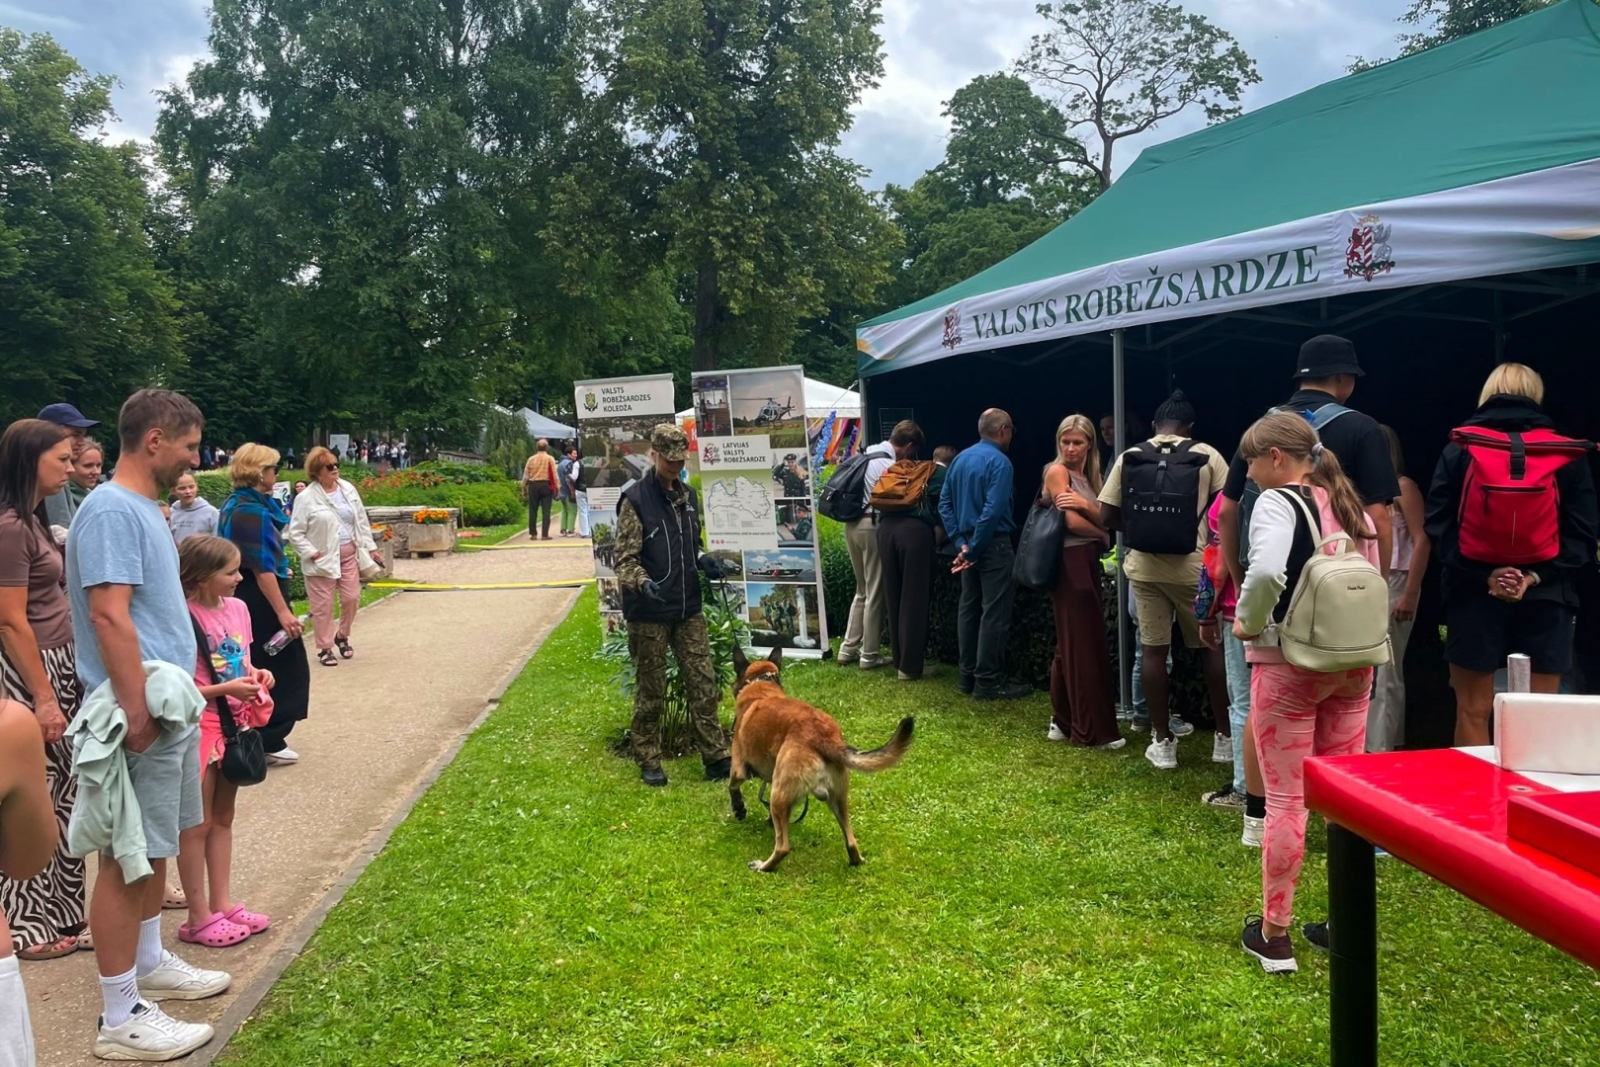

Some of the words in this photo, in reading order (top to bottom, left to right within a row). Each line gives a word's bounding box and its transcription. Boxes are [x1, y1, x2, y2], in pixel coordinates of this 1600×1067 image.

[973, 298, 1056, 339] VALSTS
[1065, 245, 1320, 325] ROBEŽSARDZE
[601, 387, 625, 395] VALSTS
[602, 394, 651, 404] ROBEŽSARDZES
[603, 404, 632, 412] KOLEDŽA
